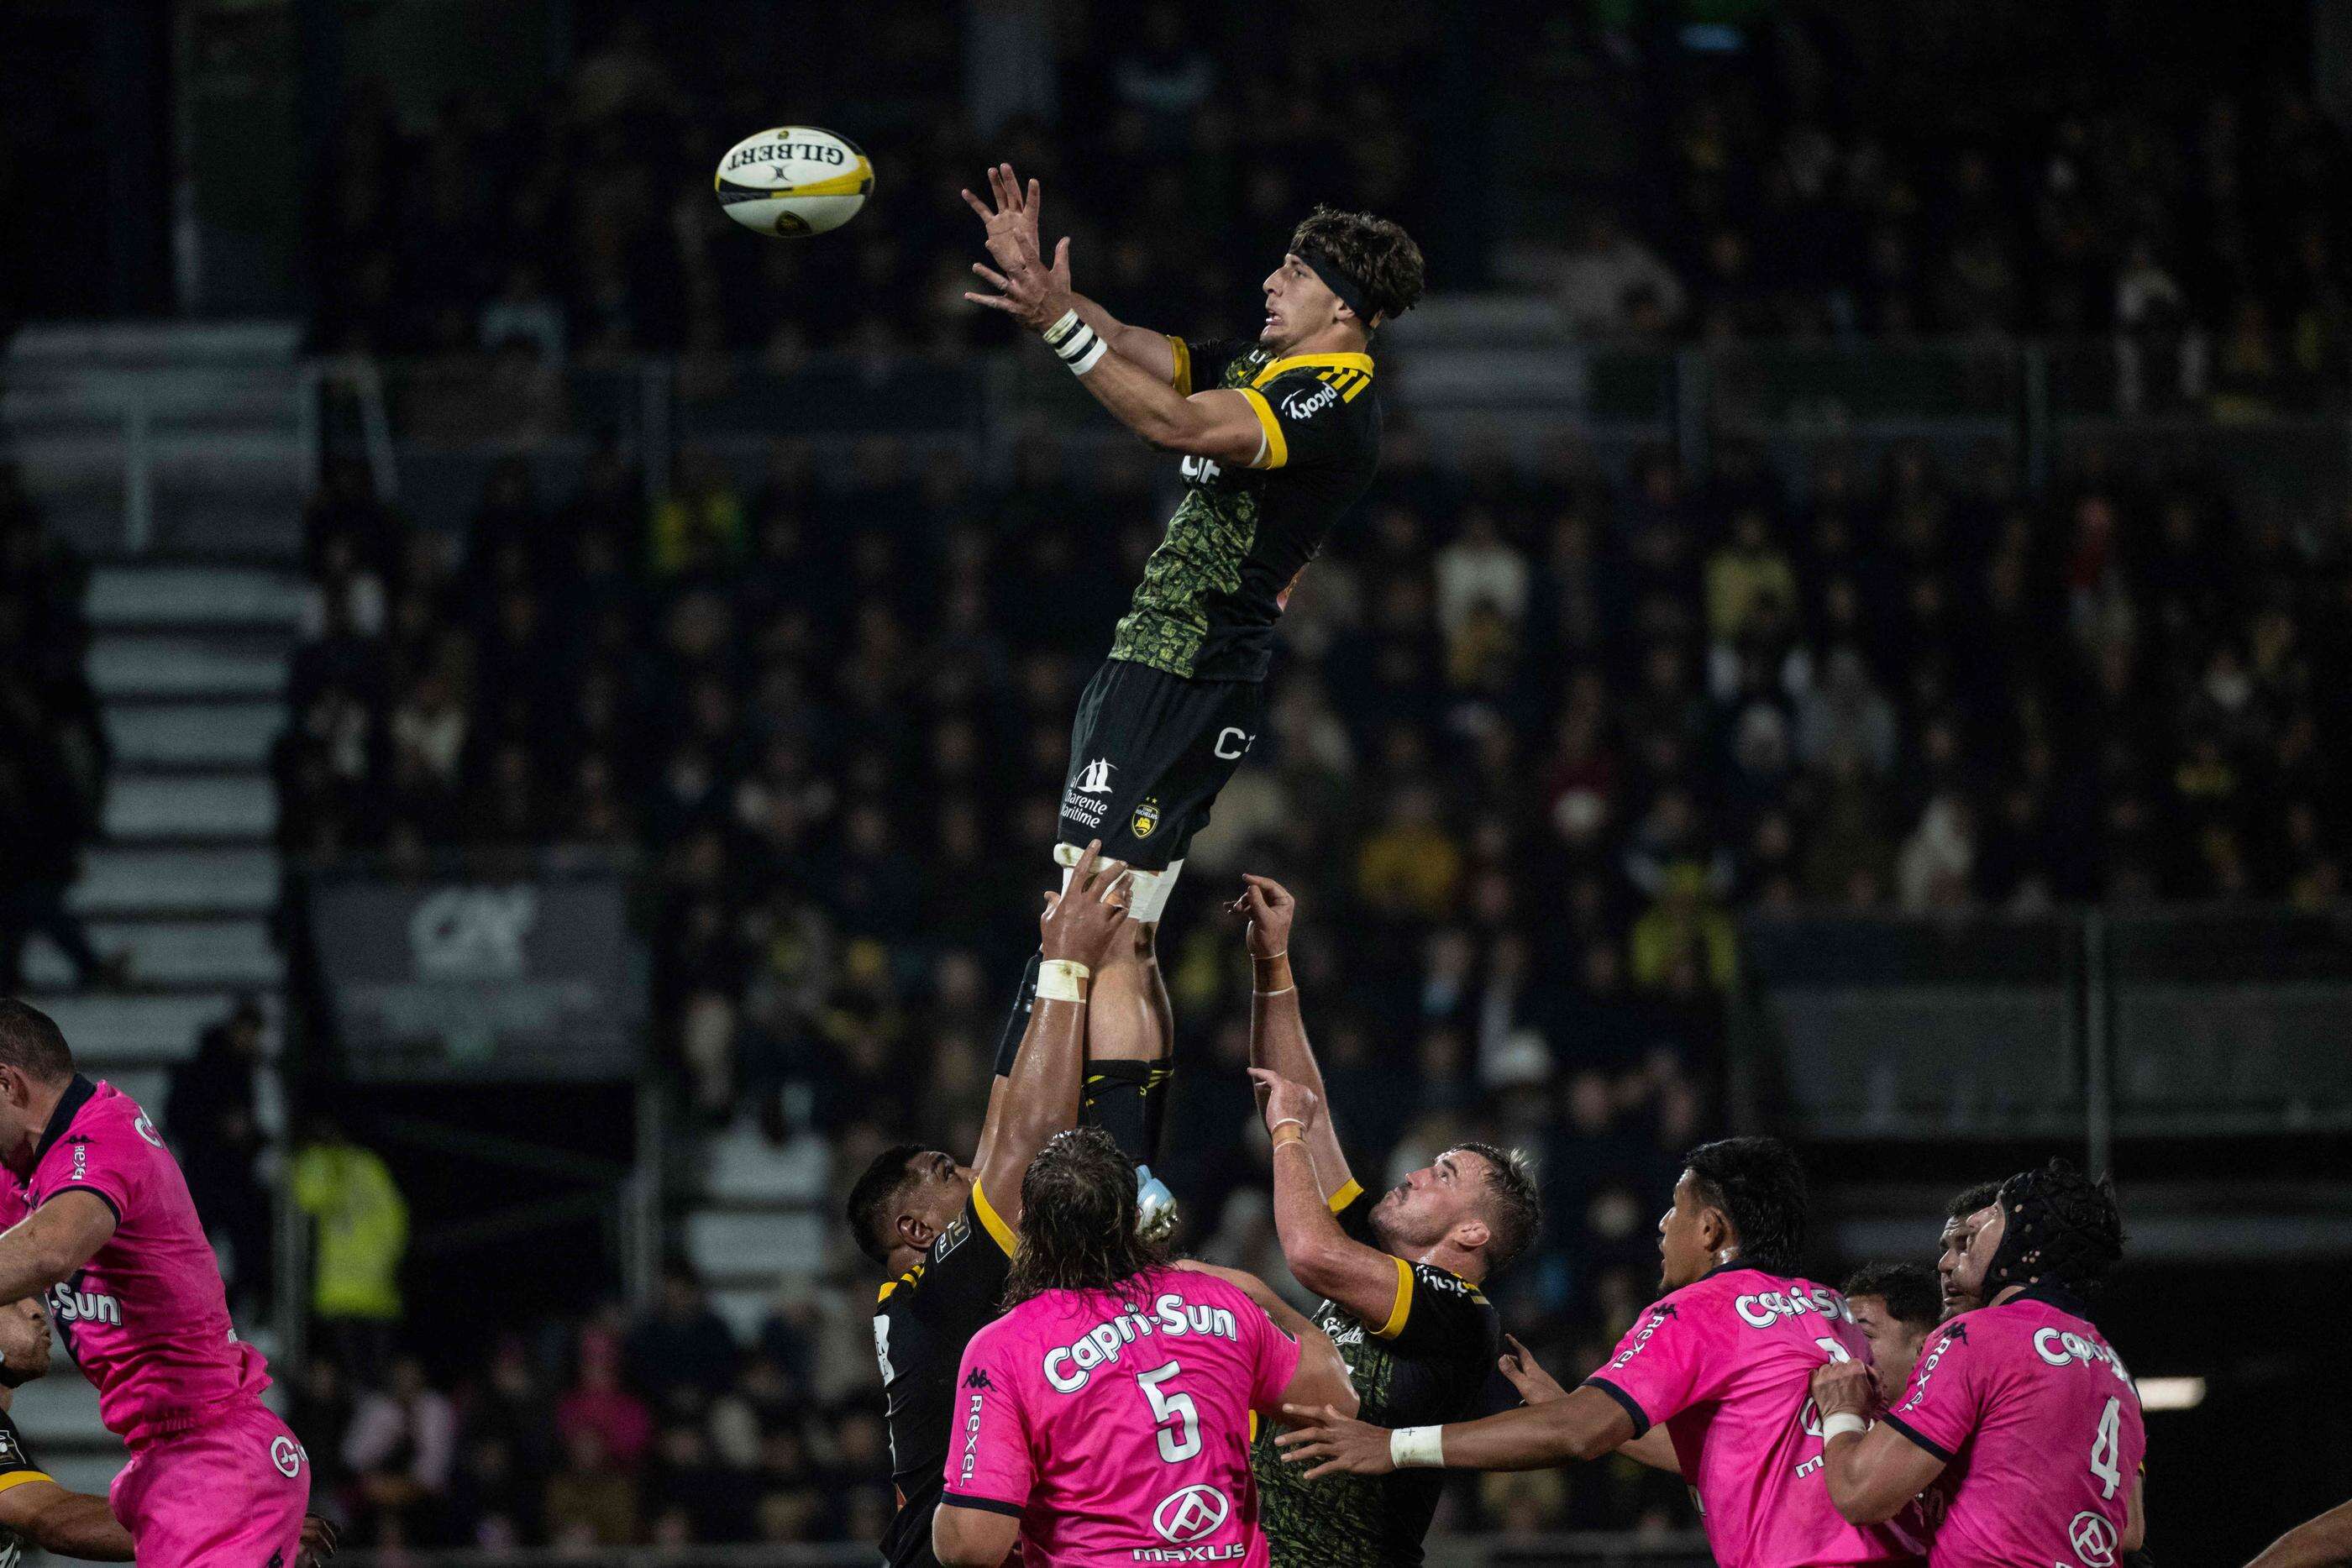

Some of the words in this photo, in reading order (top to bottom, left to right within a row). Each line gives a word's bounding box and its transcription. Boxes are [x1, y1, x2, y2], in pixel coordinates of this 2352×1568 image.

[727, 144, 845, 170] GILBERT
[1289, 381, 1337, 420] picoty
[1042, 1293, 1238, 1393] Capri-Sun
[1137, 1360, 1201, 1464] 5
[2090, 1395, 2121, 1501] 4
